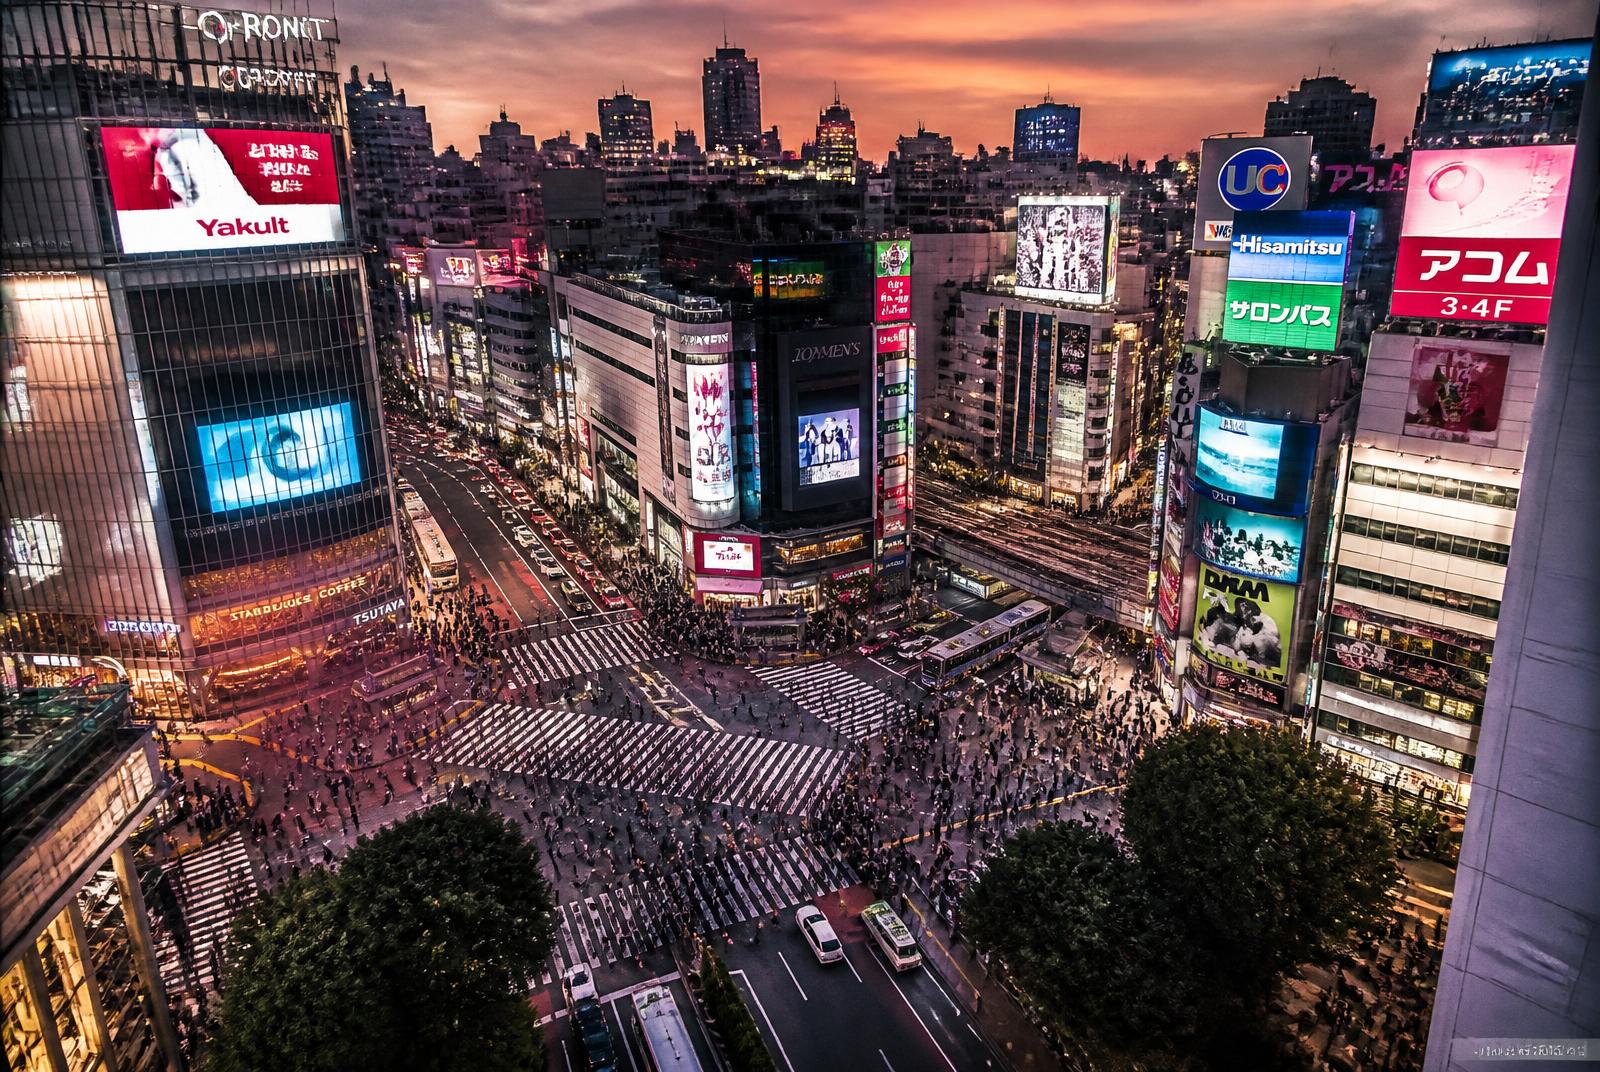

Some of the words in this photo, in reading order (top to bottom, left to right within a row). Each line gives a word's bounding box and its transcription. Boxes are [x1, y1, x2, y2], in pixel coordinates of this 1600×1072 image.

[1226, 164, 1286, 195] UC
[196, 216, 290, 236] Yakult
[1232, 234, 1343, 255] Hisamitsu
[1419, 249, 1549, 285] アコム
[1229, 300, 1332, 327] サロンパス
[319, 576, 367, 599] COFFEE
[353, 598, 406, 625] TSUTAYA
